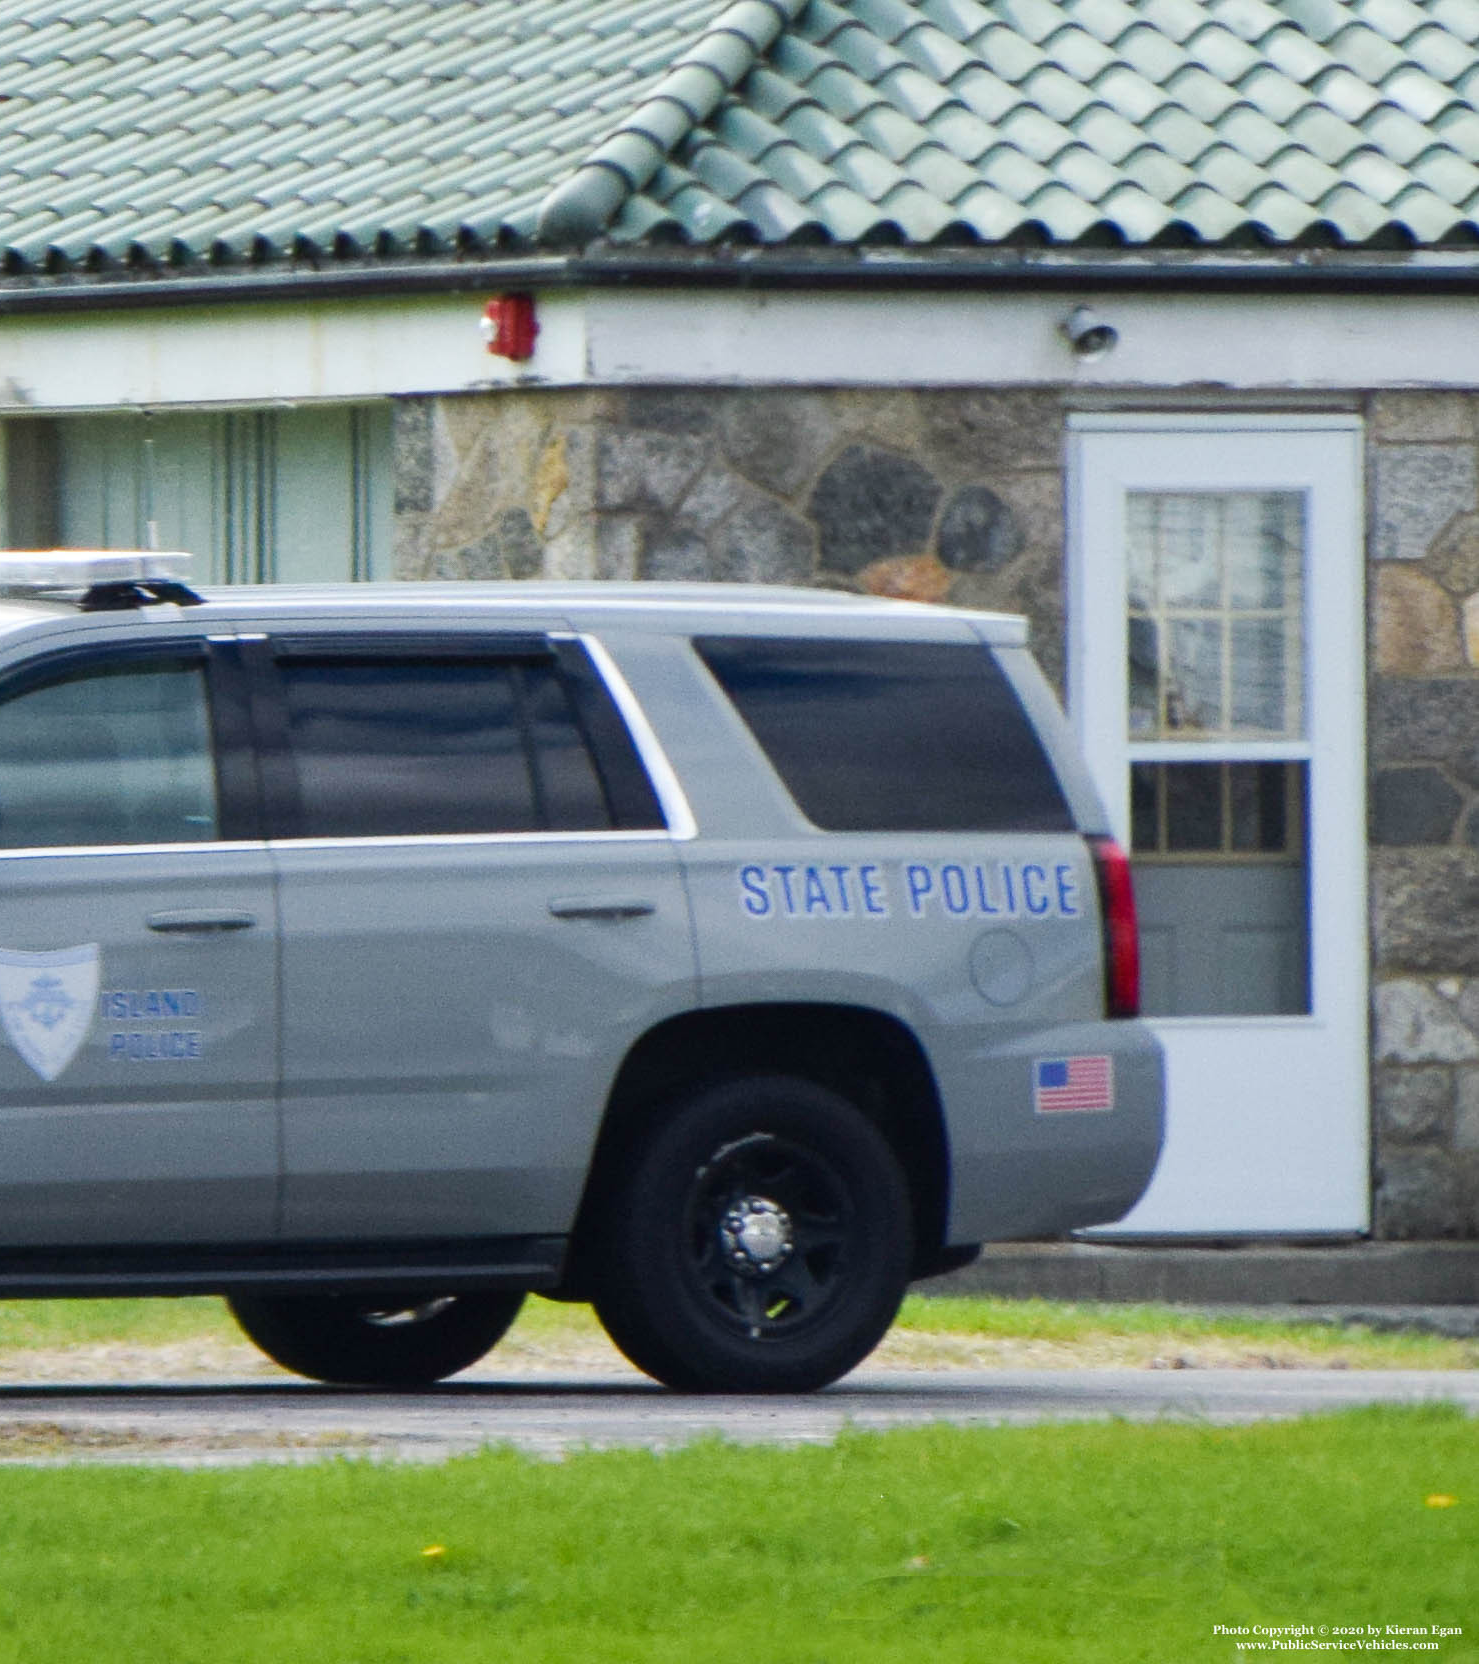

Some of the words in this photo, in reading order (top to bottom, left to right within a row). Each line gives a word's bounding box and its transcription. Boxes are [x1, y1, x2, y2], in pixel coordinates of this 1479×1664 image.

[739, 863, 886, 916] STATE
[906, 863, 1077, 916] POLICE
[101, 990, 200, 1020] ISLAND
[111, 1031, 201, 1060] POLICE
